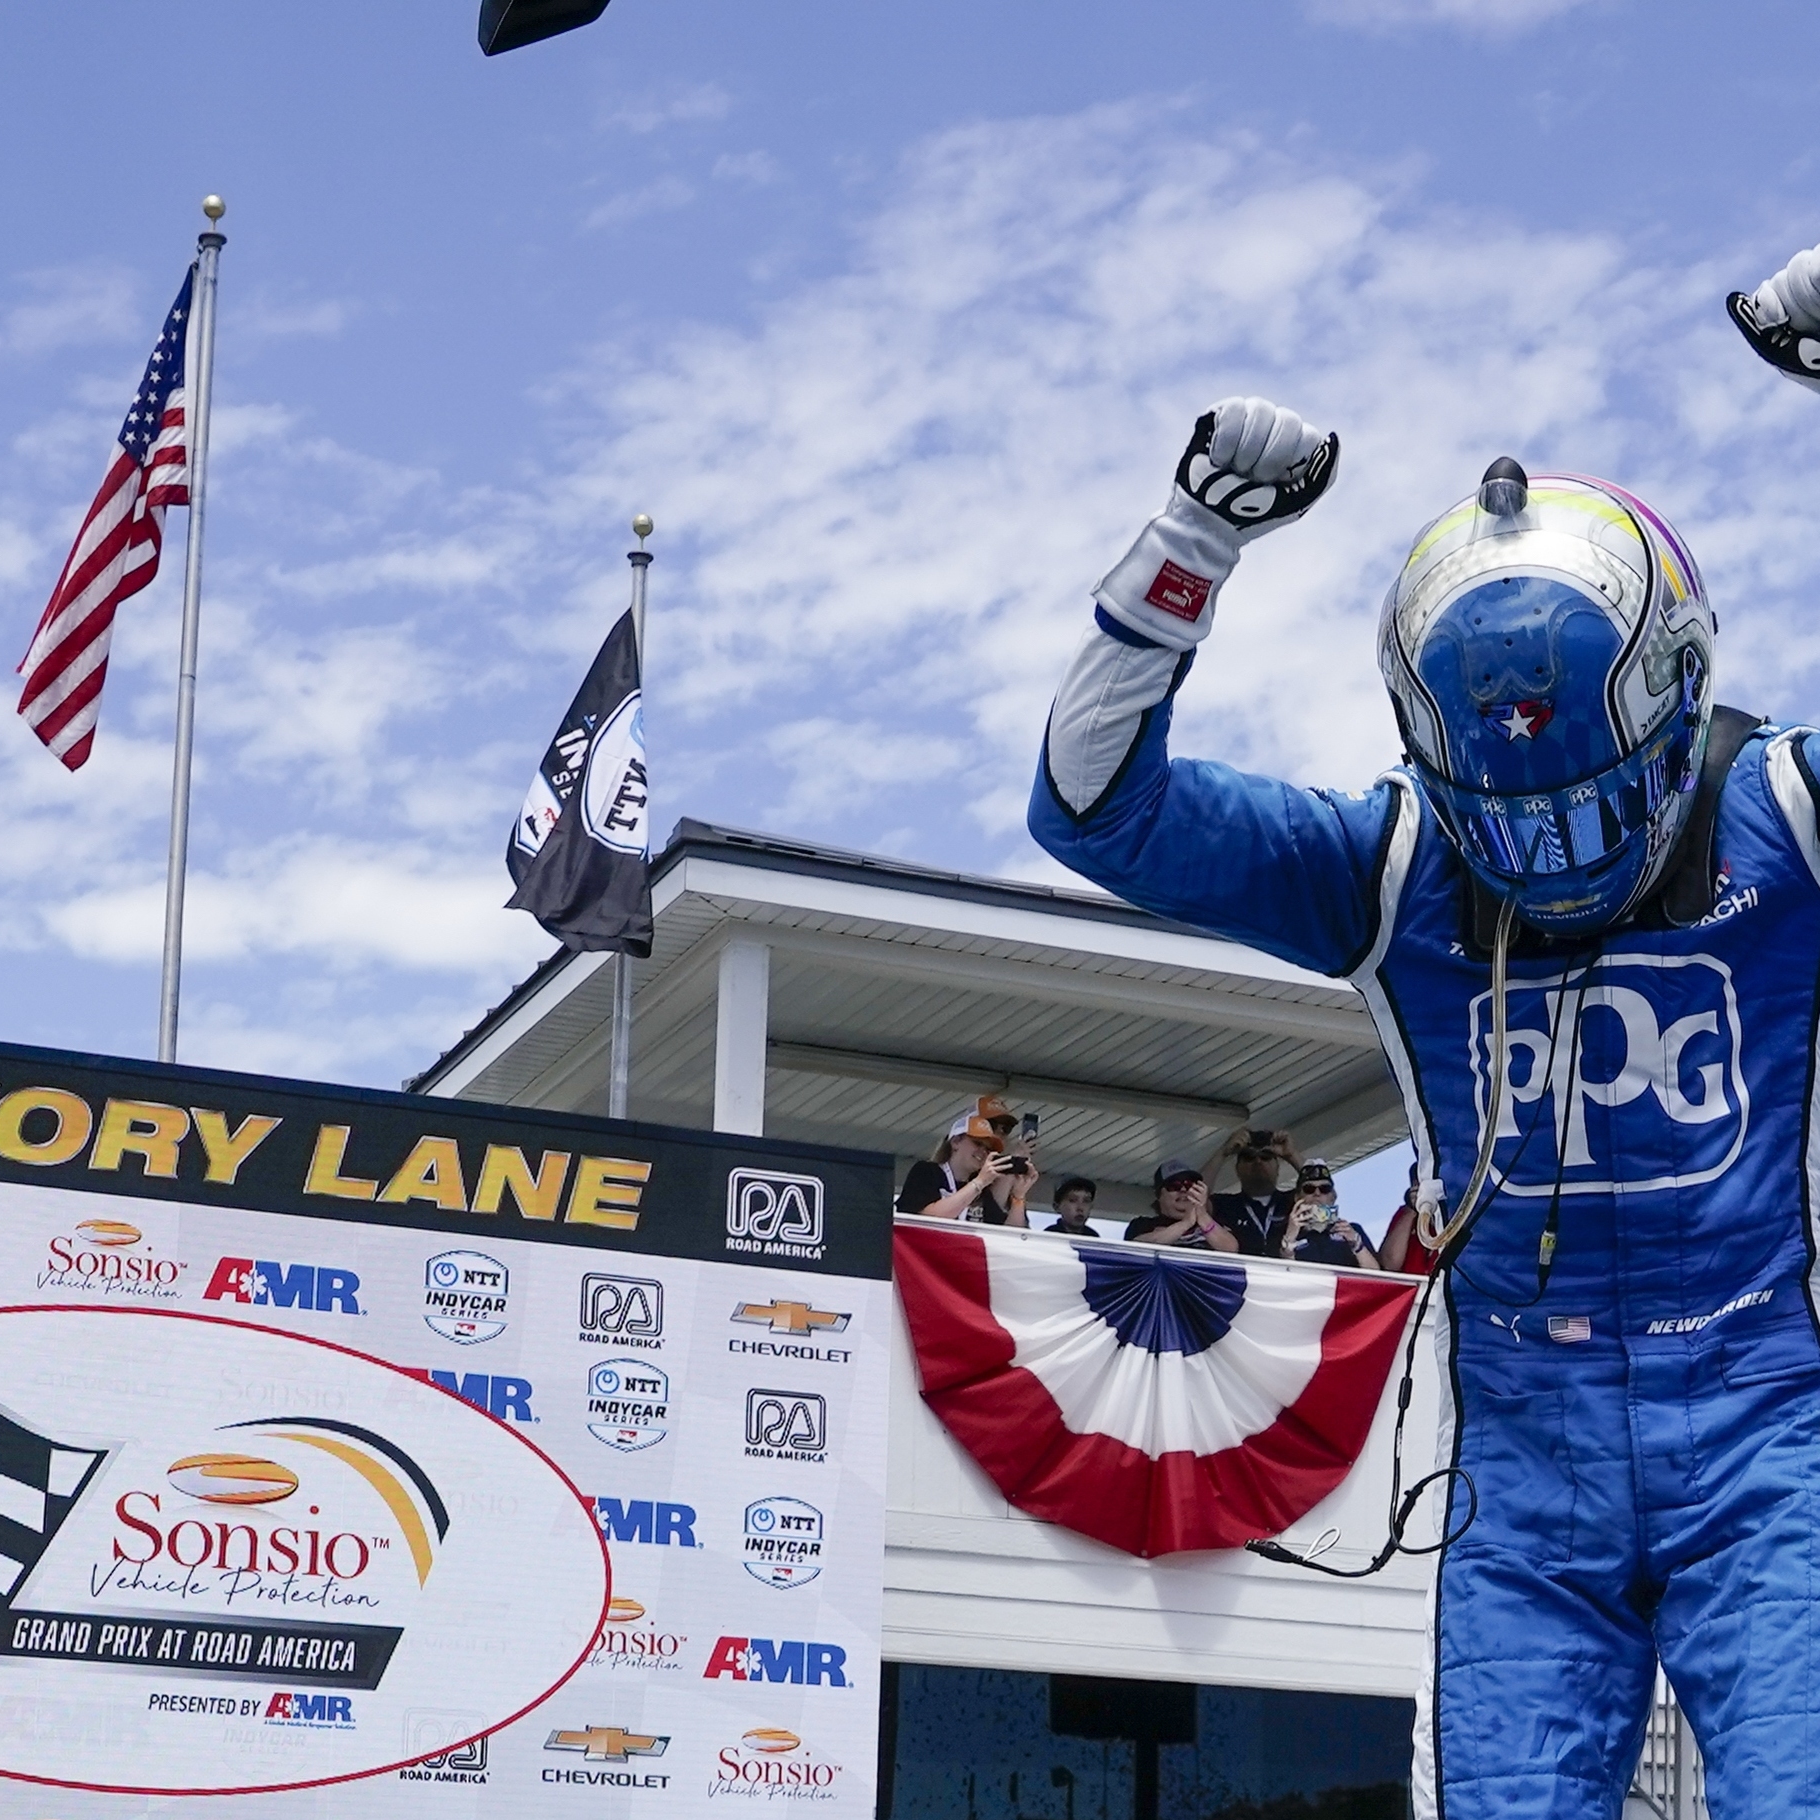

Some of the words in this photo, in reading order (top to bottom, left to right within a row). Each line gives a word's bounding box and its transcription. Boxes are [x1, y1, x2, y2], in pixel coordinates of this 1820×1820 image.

[1485, 986, 1731, 1166] PPG
[302, 1124, 651, 1231] LANE
[726, 1237, 761, 1252] ROAD
[764, 1242, 821, 1259] AMERICA
[48, 1238, 178, 1284] Sonsio
[203, 1257, 360, 1315] AMR
[464, 1270, 500, 1286] NTT
[426, 1291, 508, 1313] INDYCAR
[579, 1333, 609, 1344] ROAD
[612, 1336, 661, 1349] AMERICA
[729, 1340, 851, 1362] CHEVROLET
[625, 1377, 660, 1393] NTT
[589, 1397, 668, 1420] INDYCAR
[745, 1447, 774, 1458] ROAD
[777, 1450, 824, 1463] AMERICA
[781, 1515, 815, 1531] NTT
[112, 1492, 369, 1580] Sonsio
[745, 1536, 822, 1559] INDYCAR
[90, 1560, 209, 1600] Vehicle
[219, 1566, 380, 1608] Protection
[13, 1618, 91, 1653] GRAND
[98, 1624, 153, 1657] PRIX
[157, 1629, 187, 1659] AT
[191, 1631, 252, 1664] ROAD
[257, 1636, 354, 1671] AMERICA
[598, 1621, 678, 1657] onsio
[703, 1636, 846, 1687] AMR
[148, 1694, 236, 1714] PRESENTED
[240, 1700, 261, 1716] BY
[264, 1692, 352, 1722] AMR
[400, 1770, 431, 1781] ROAD
[434, 1772, 486, 1784] AMERICA
[542, 1769, 670, 1788] CHEVROLET
[715, 1748, 833, 1786] Sonsio
